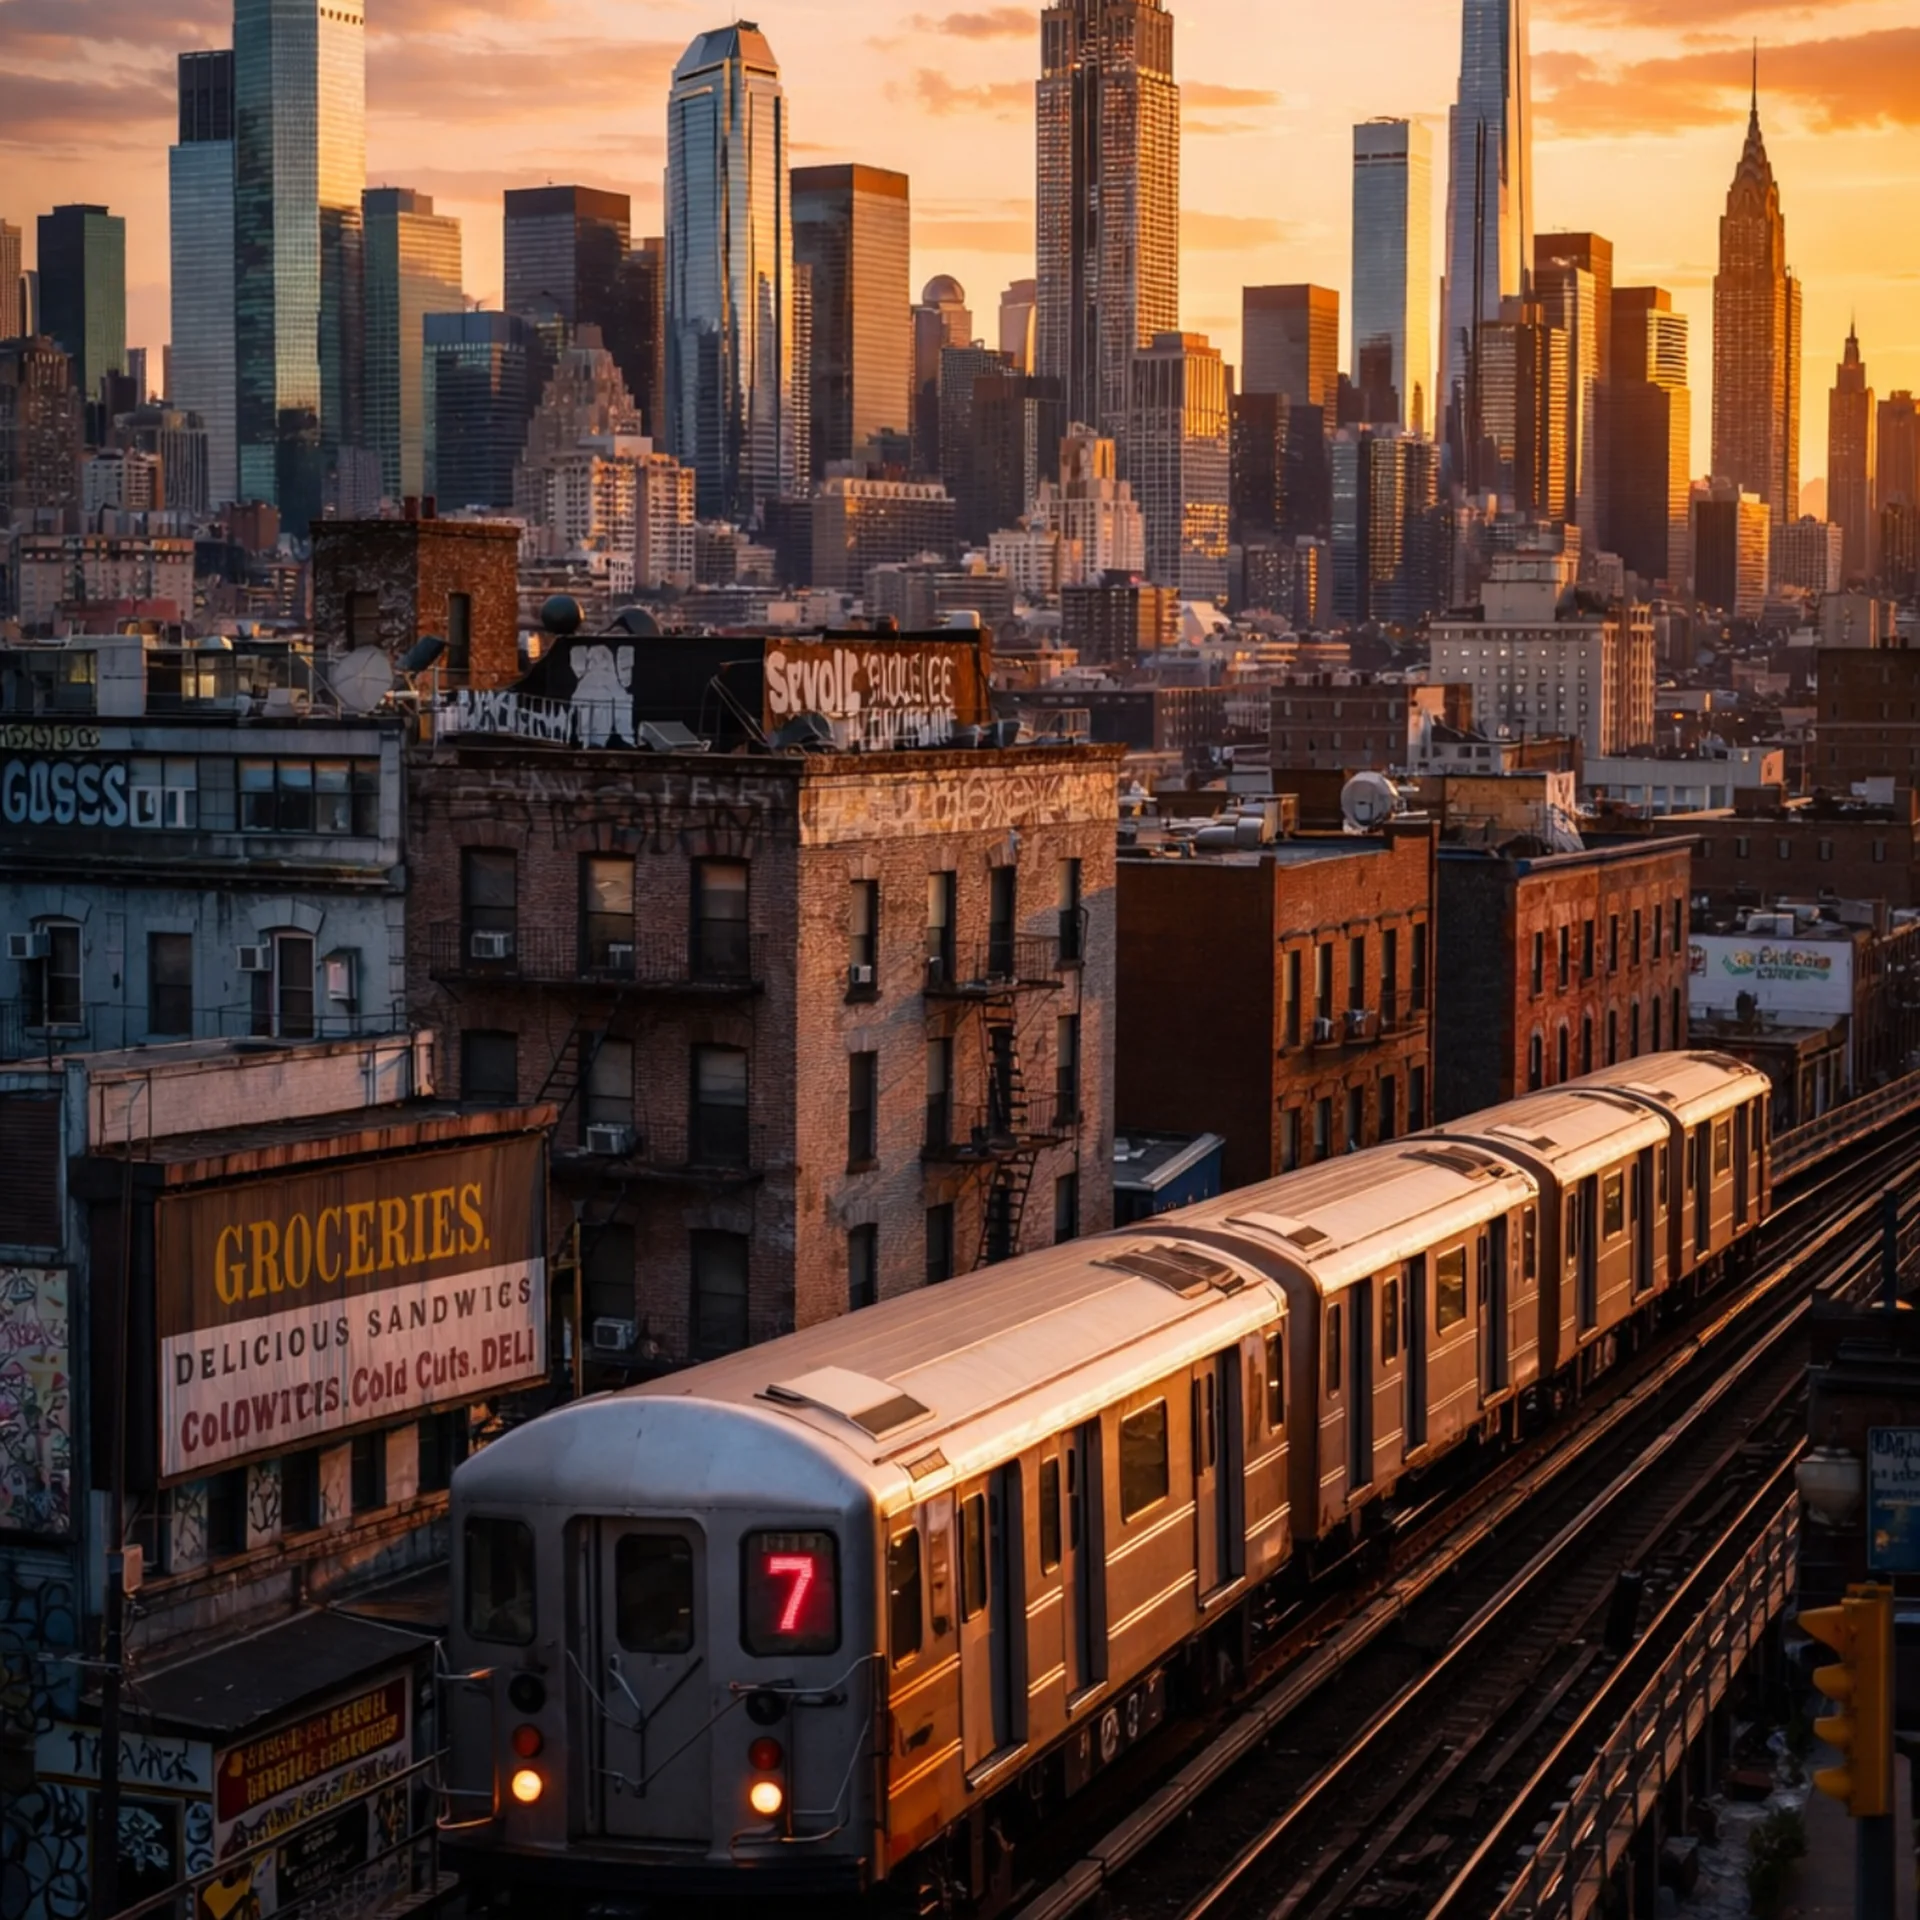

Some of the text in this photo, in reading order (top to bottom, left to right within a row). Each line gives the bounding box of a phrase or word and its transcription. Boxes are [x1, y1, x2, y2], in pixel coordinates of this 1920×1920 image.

[214, 1182, 490, 1304] GROCERIES.
[176, 1316, 349, 1386] DELICIOUS
[769, 1556, 813, 1630] 7
